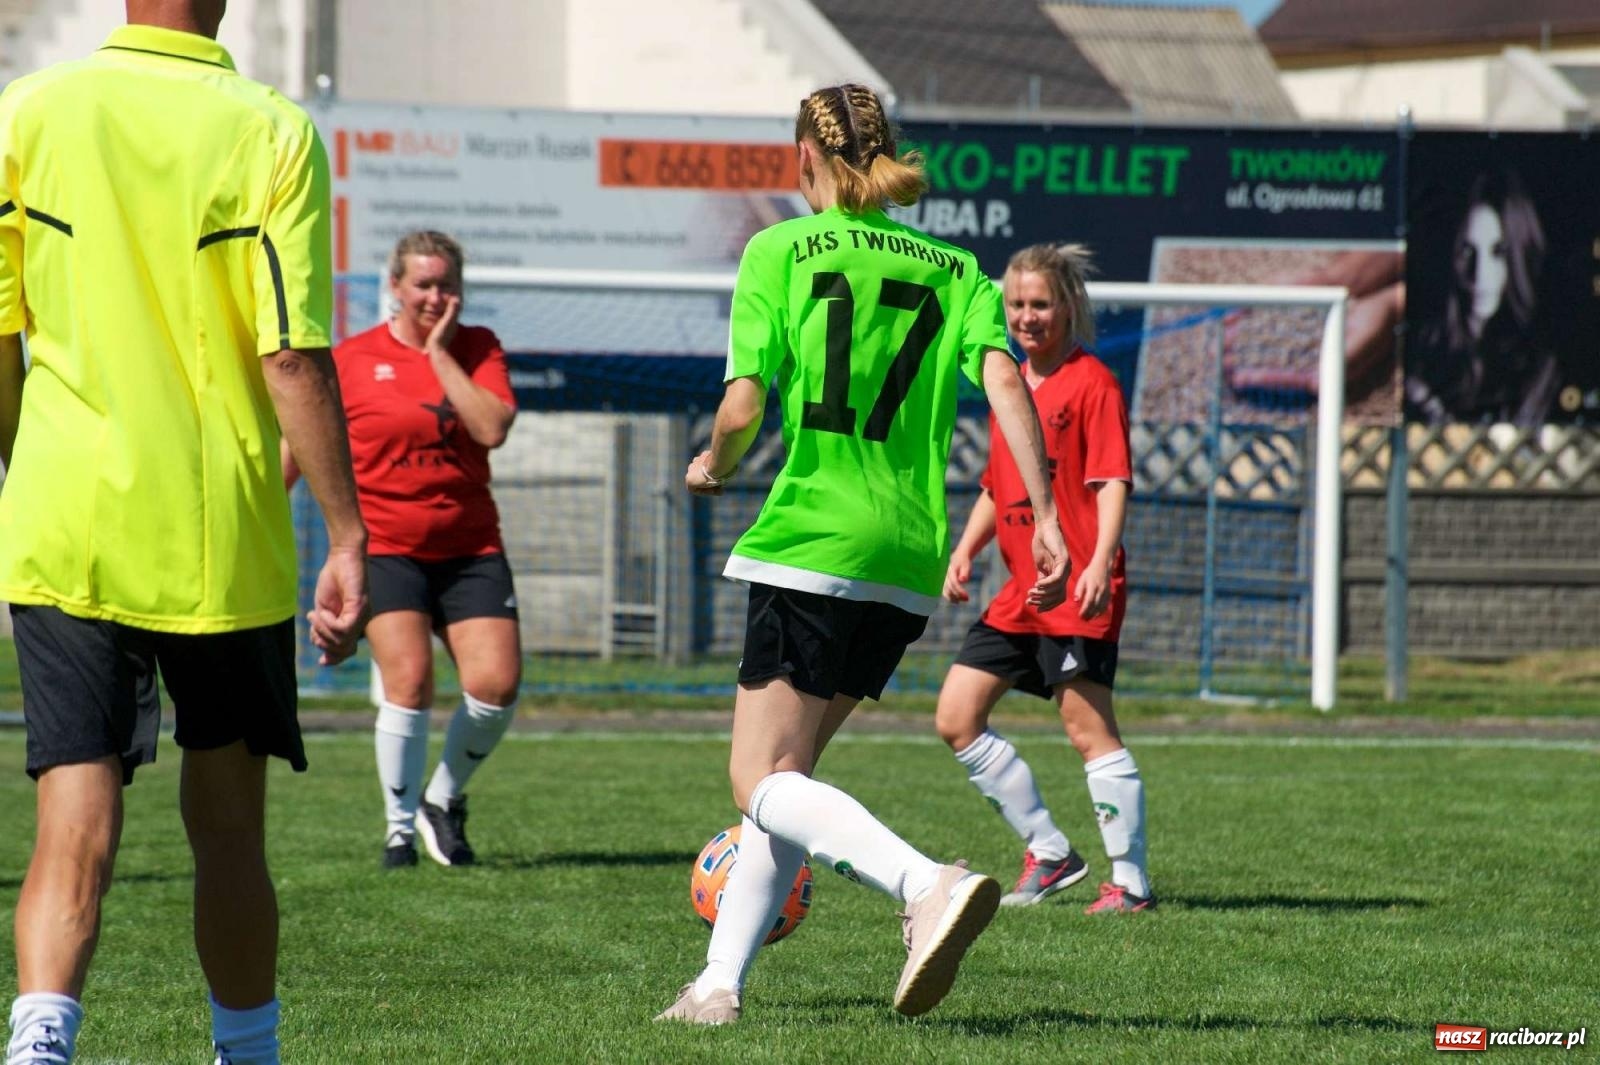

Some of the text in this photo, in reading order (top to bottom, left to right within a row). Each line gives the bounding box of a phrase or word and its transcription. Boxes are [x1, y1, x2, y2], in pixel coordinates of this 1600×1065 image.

[401, 132, 459, 155] BAU
[655, 142, 786, 190] 666 859
[1229, 144, 1386, 181] TWORKÓW
[1254, 182, 1357, 213] Ogrodowa
[984, 199, 1012, 237] P.
[792, 230, 839, 264] LKS
[801, 271, 945, 443] 17
